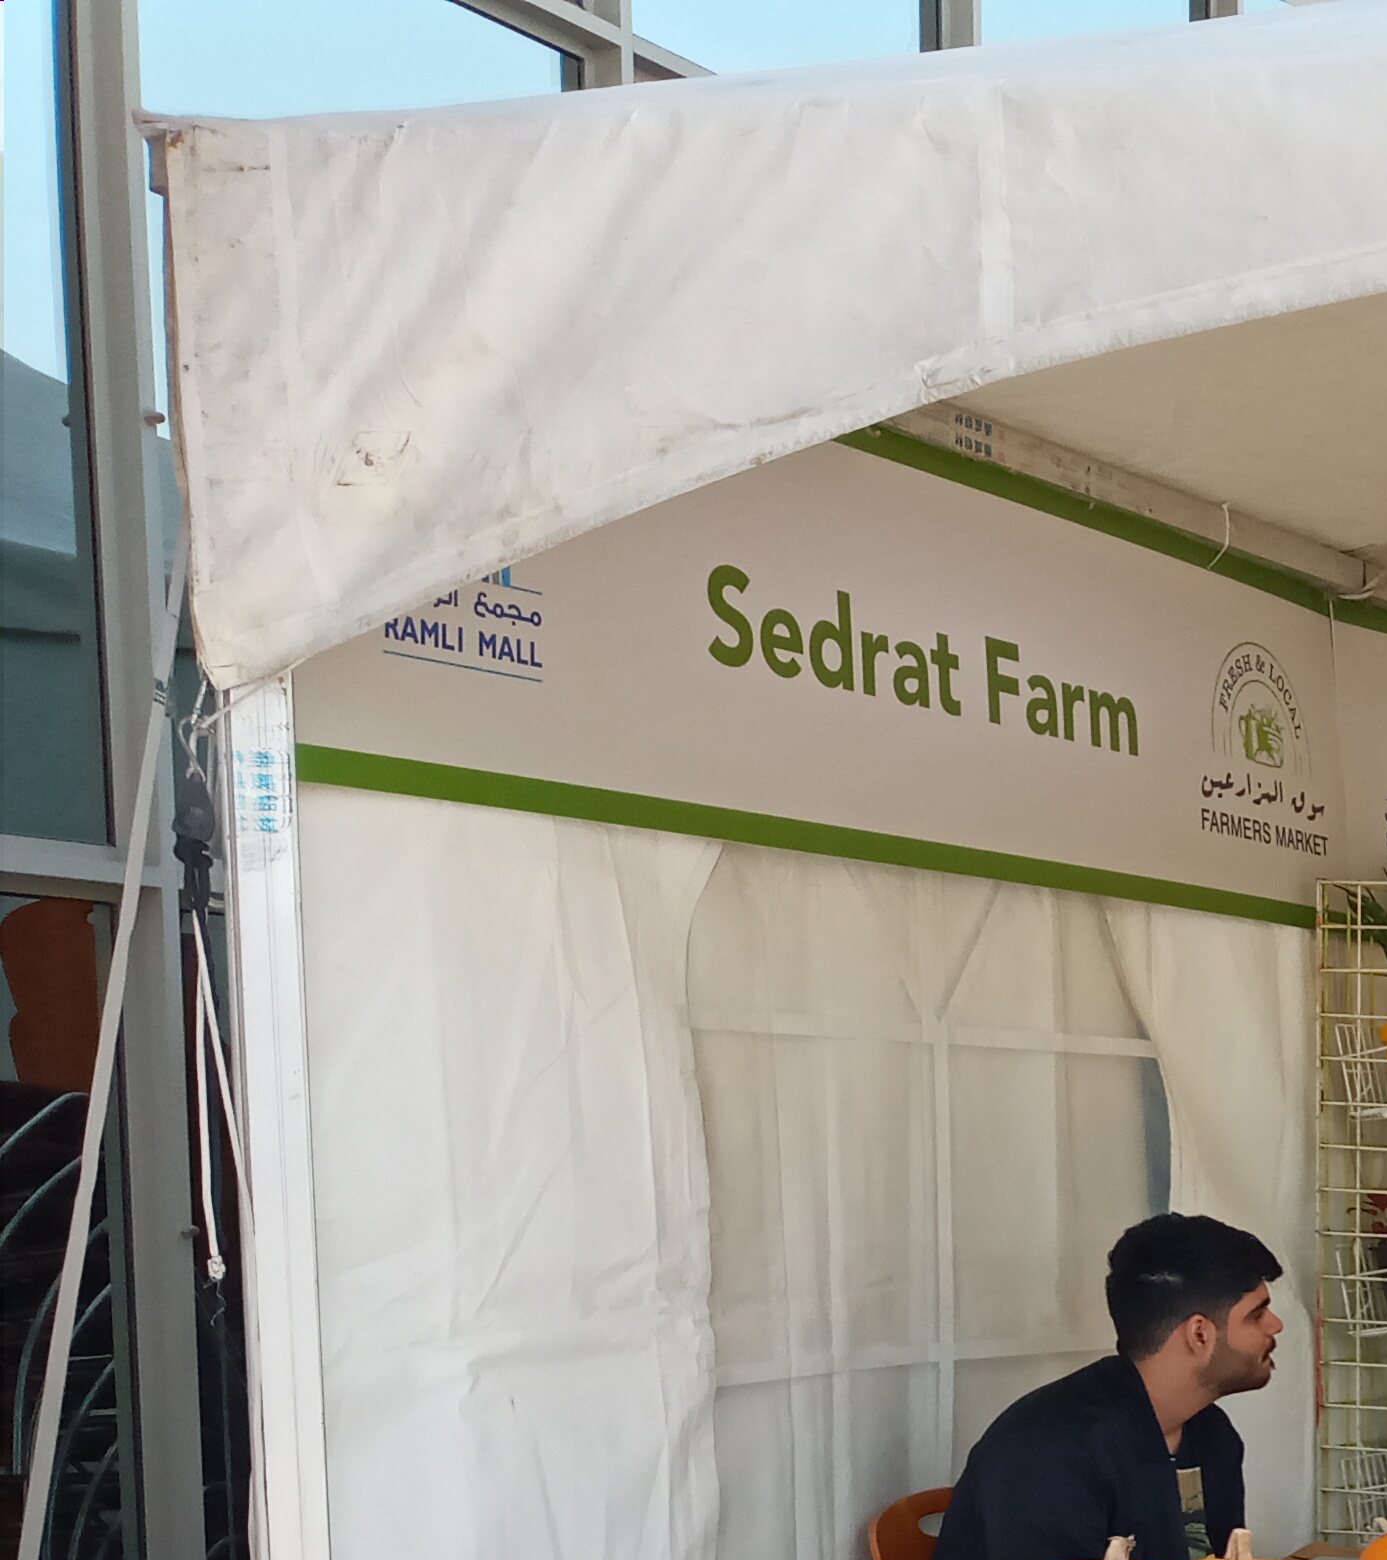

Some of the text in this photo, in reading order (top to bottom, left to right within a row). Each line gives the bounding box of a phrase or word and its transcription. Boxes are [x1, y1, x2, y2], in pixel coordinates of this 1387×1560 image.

[474, 591, 542, 627] مجمع
[384, 615, 543, 668] RAMLI MALL
[707, 564, 1139, 757] Sedrat Farm
[1219, 653, 1253, 713] FRESH
[1268, 663, 1302, 740] LOCAL
[1201, 807, 1329, 857] FARMERS MARKET
